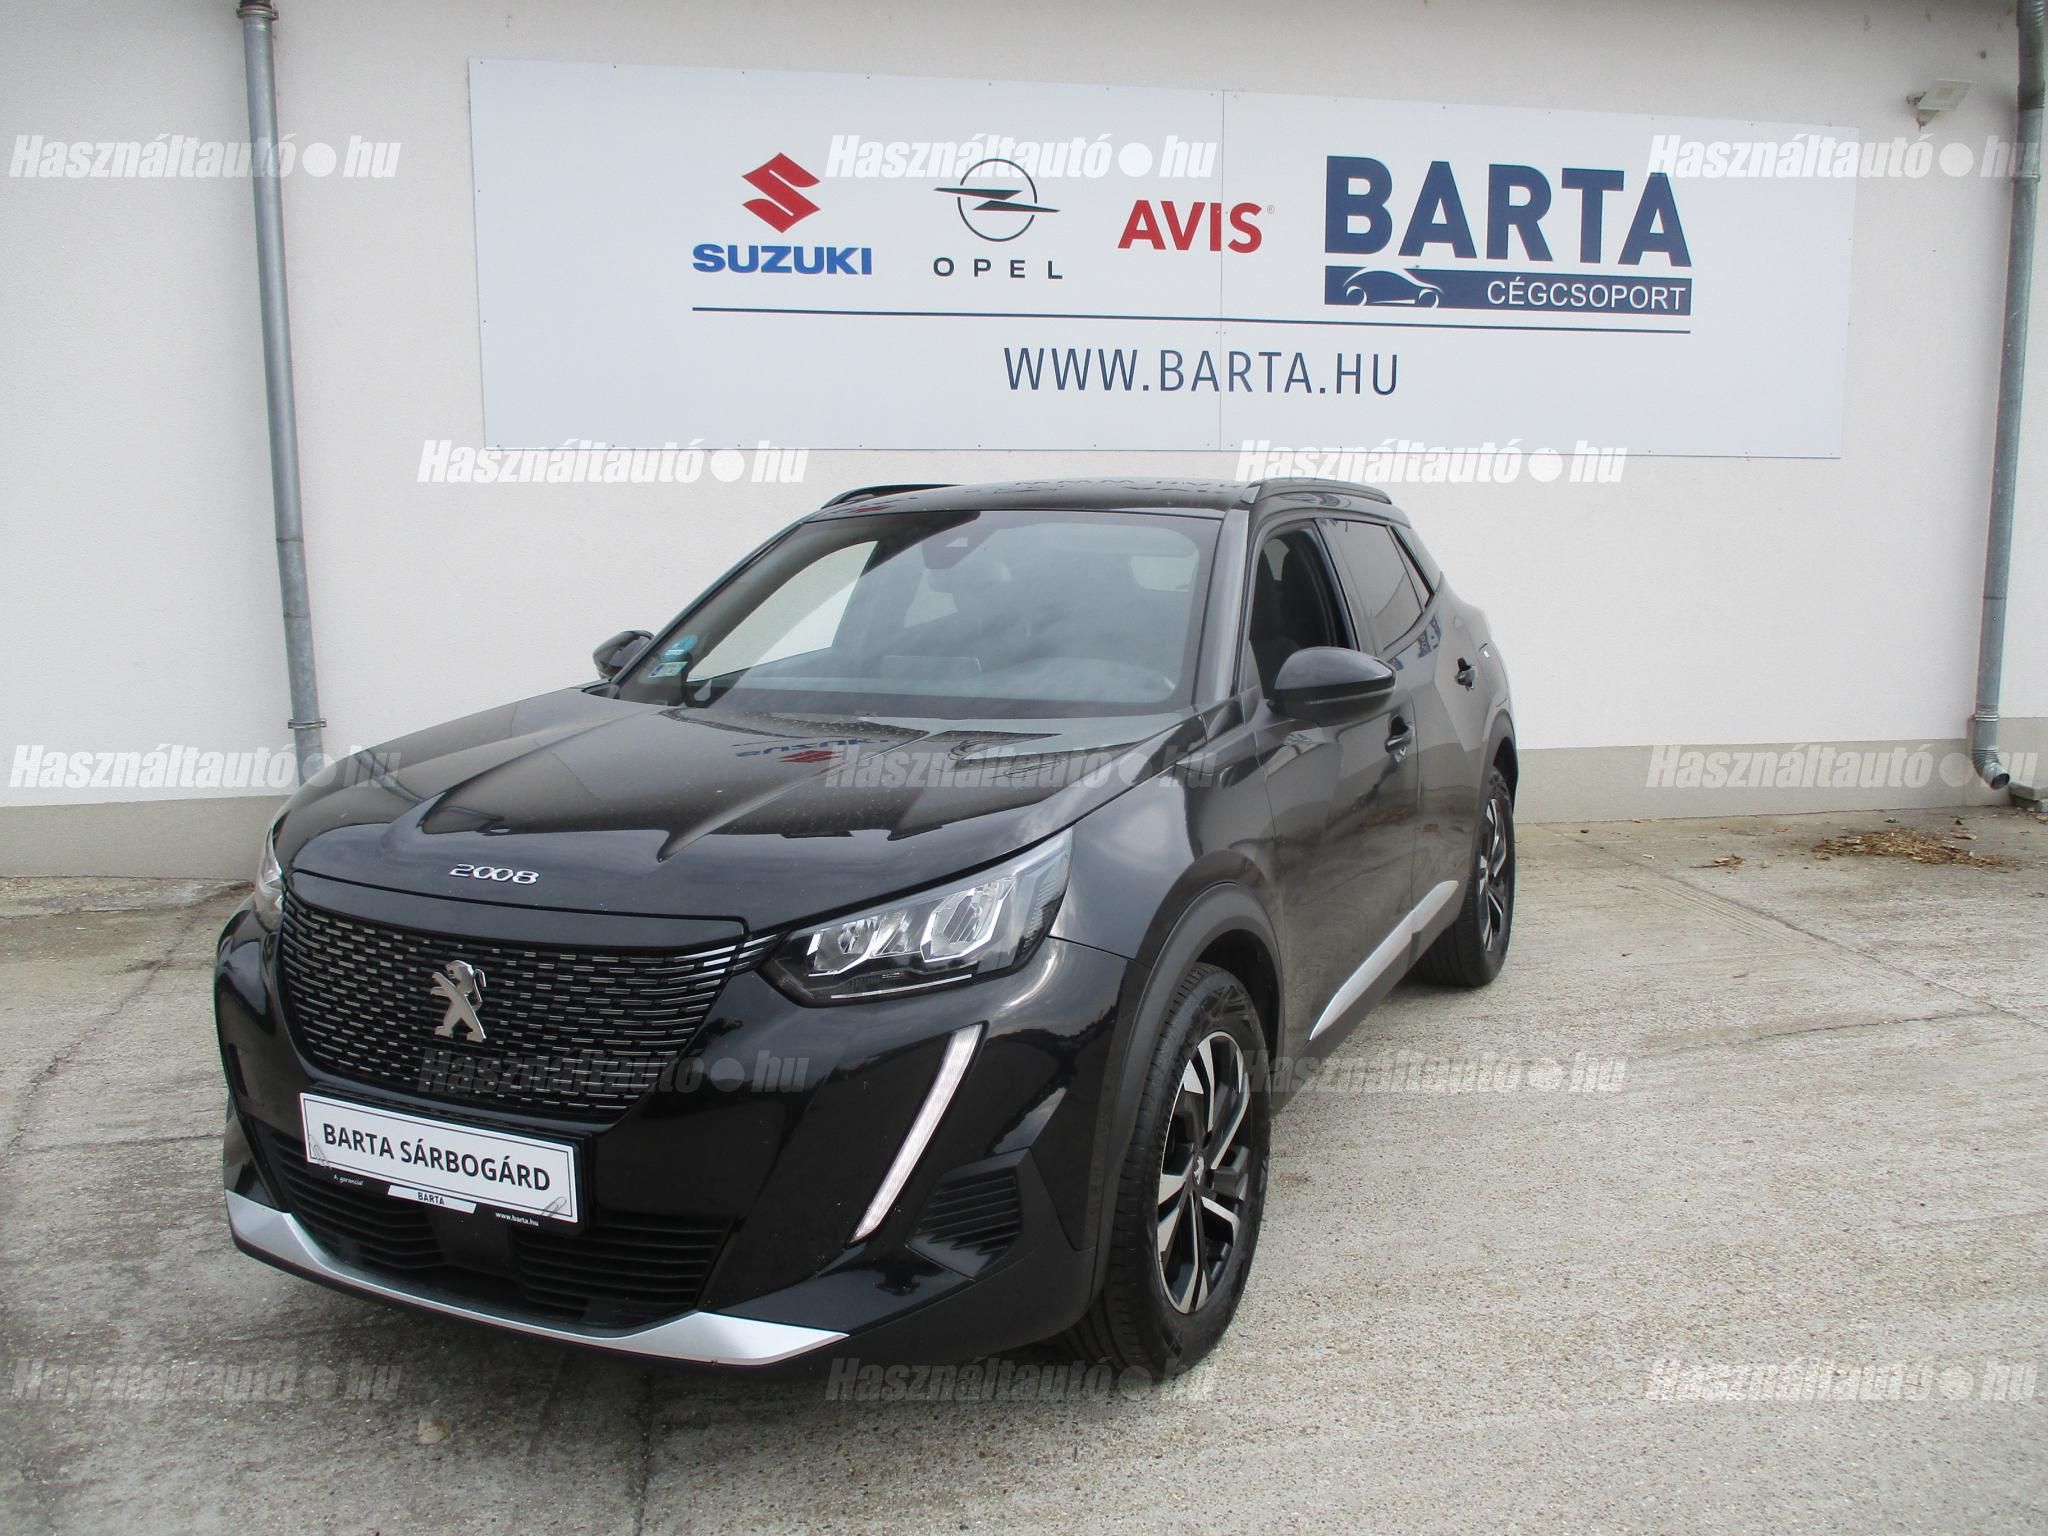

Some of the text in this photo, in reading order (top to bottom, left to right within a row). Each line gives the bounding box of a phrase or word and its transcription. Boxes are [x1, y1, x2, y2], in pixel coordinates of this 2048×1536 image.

[1118, 199, 1263, 253] AVIS
[1325, 154, 1692, 268] BARTA
[692, 243, 872, 275] SUZUKI
[933, 257, 1063, 279] OPEL
[1486, 276, 1687, 311] CÉGCSOPORT
[1004, 346, 1399, 396] WWW.BARTA.HU
[449, 863, 540, 885] 2008
[323, 1123, 551, 1191] BARTA SÁRBOGÁRD
[417, 1192, 445, 1206] BARTA
[495, 1212, 539, 1226] www.barta.hu
